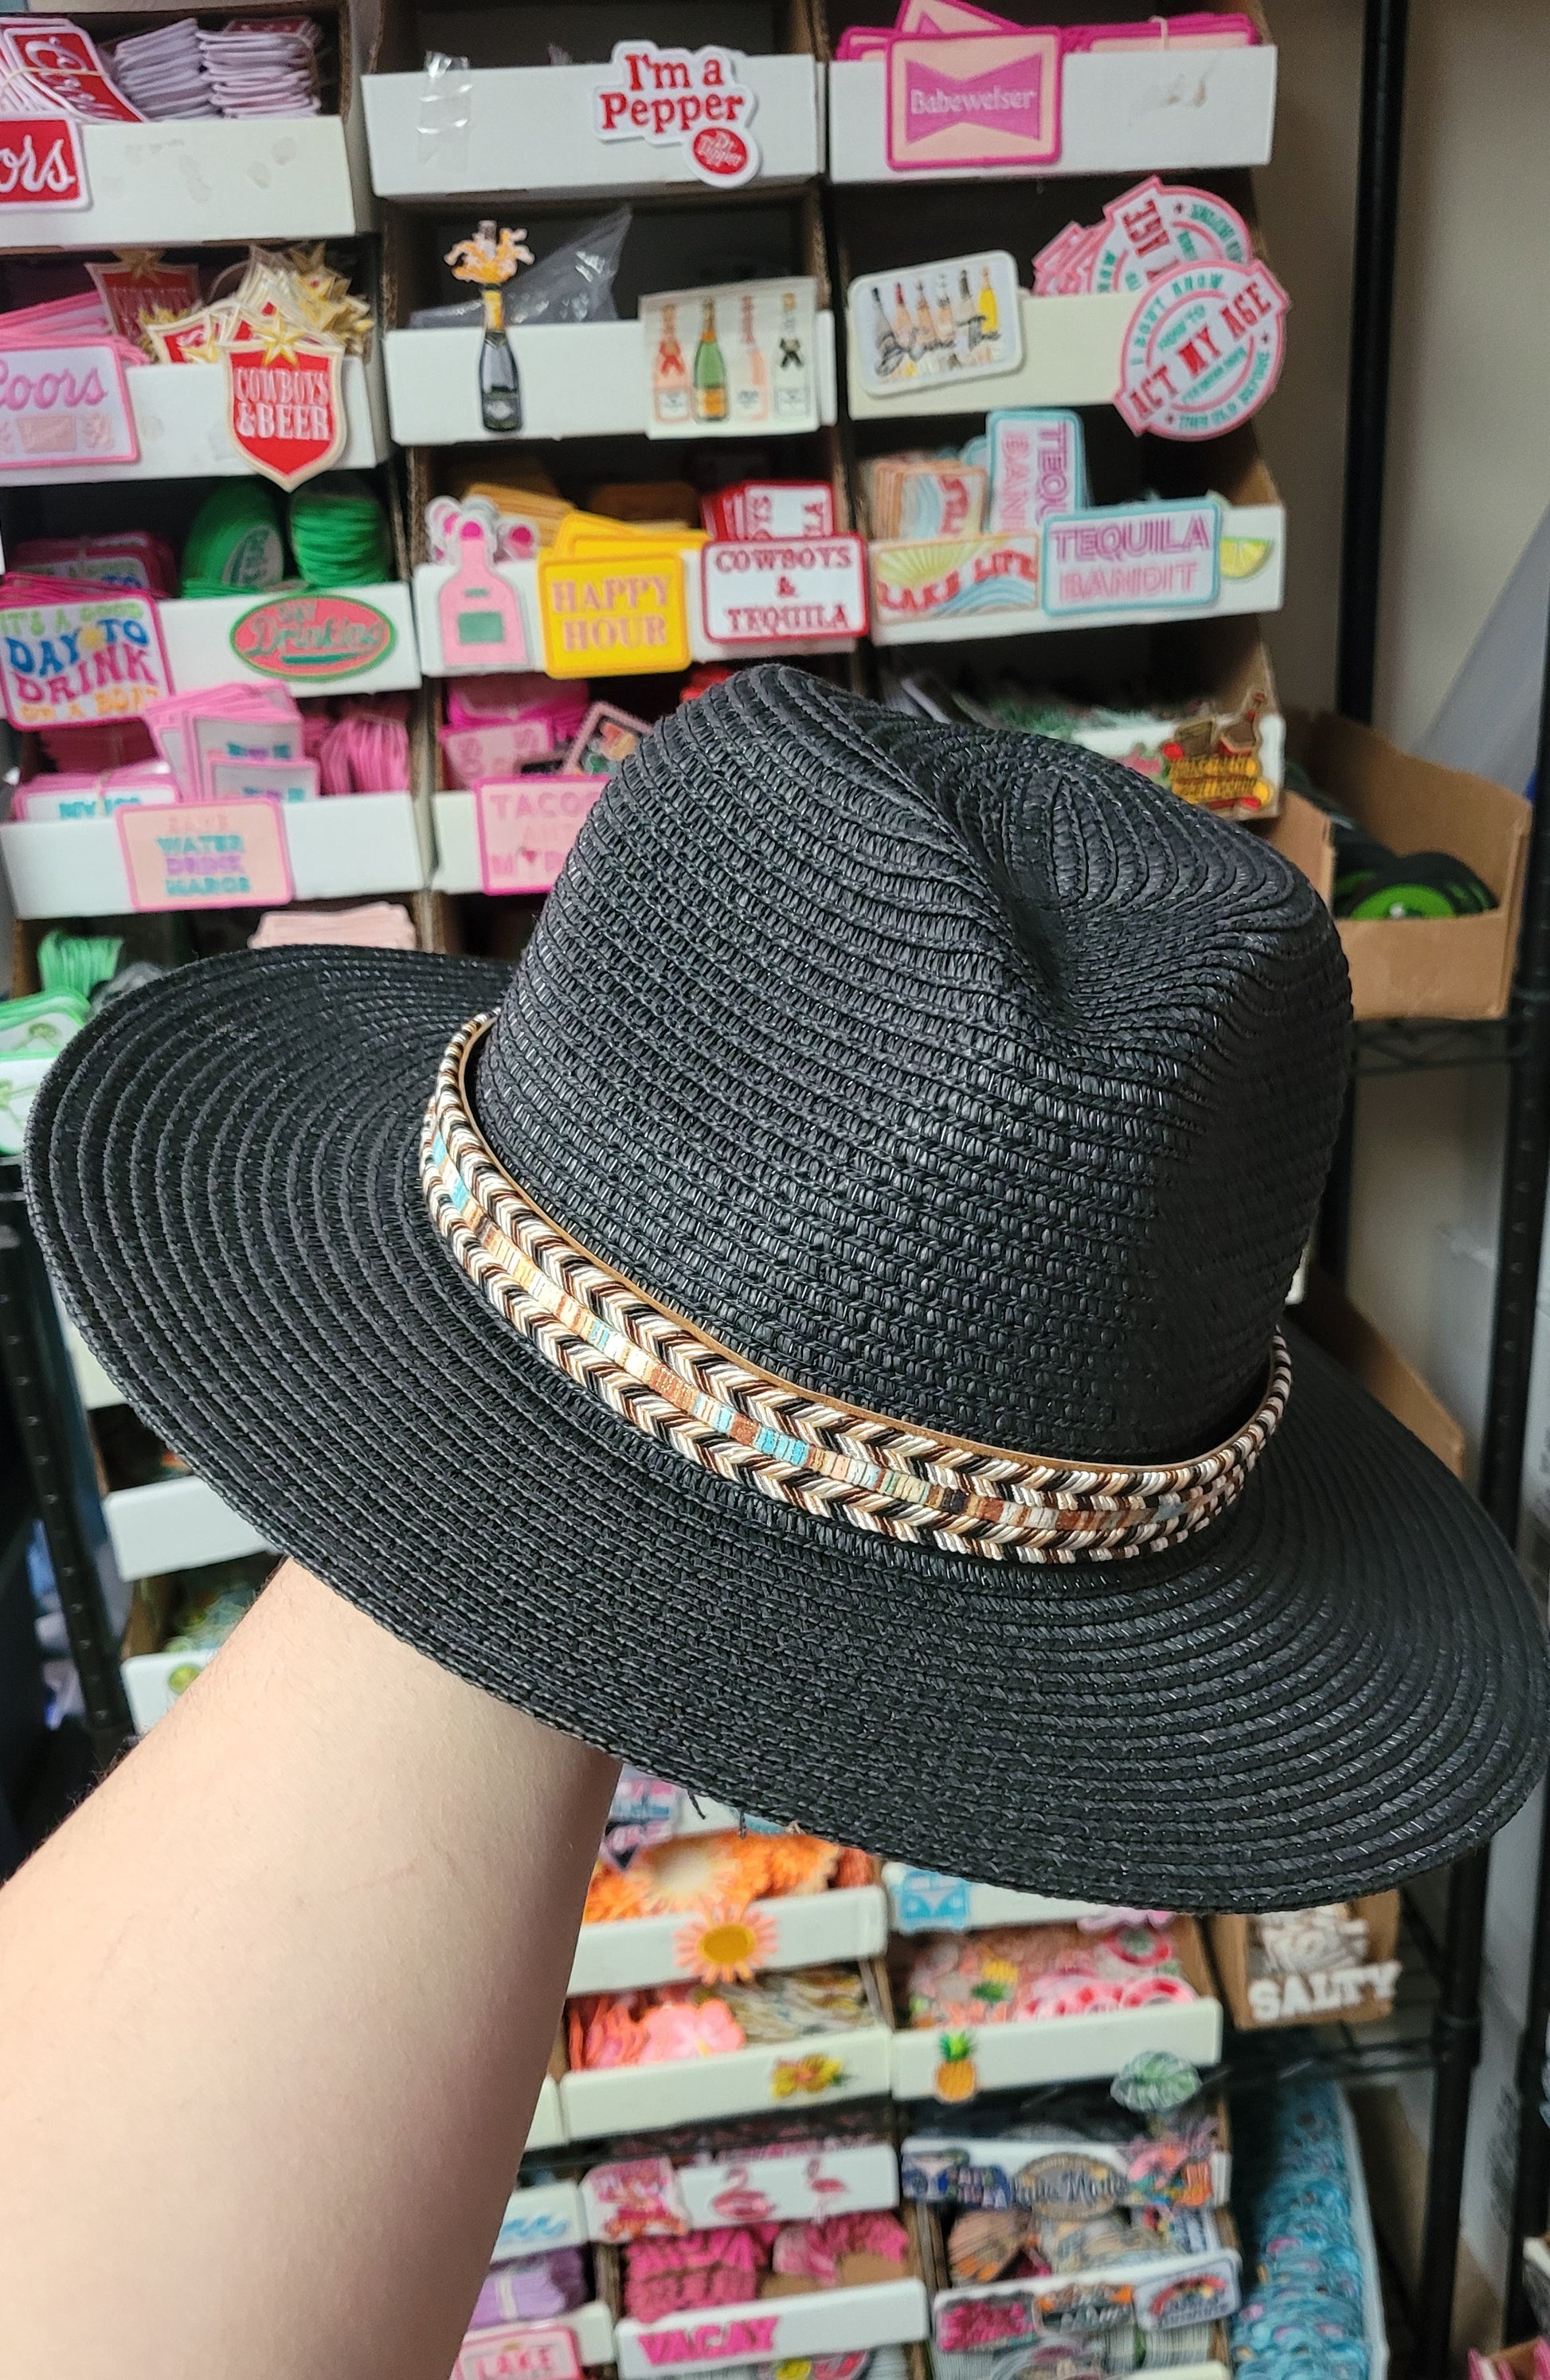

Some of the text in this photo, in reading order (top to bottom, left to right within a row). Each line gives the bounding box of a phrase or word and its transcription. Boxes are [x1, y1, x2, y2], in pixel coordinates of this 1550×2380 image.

[624, 53, 723, 91] I'm a
[600, 92, 744, 134] Pepper
[1129, 363, 1180, 419] ACT
[1220, 281, 1272, 340] AGE
[257, 404, 331, 440] BEER
[1050, 516, 1210, 561] TEQUILA
[715, 547, 851, 573] COWBOYS
[551, 575, 671, 613] HAPPY
[777, 576, 795, 596] &
[1059, 561, 1199, 604] BANDIT
[564, 614, 667, 651] HOUR
[727, 604, 849, 635] TEQUILA
[5, 618, 150, 676] DAY TO
[10, 643, 157, 705] DRINK
[1248, 1960, 1403, 2025] SALTY
[638, 2315, 778, 2367] VACAY
